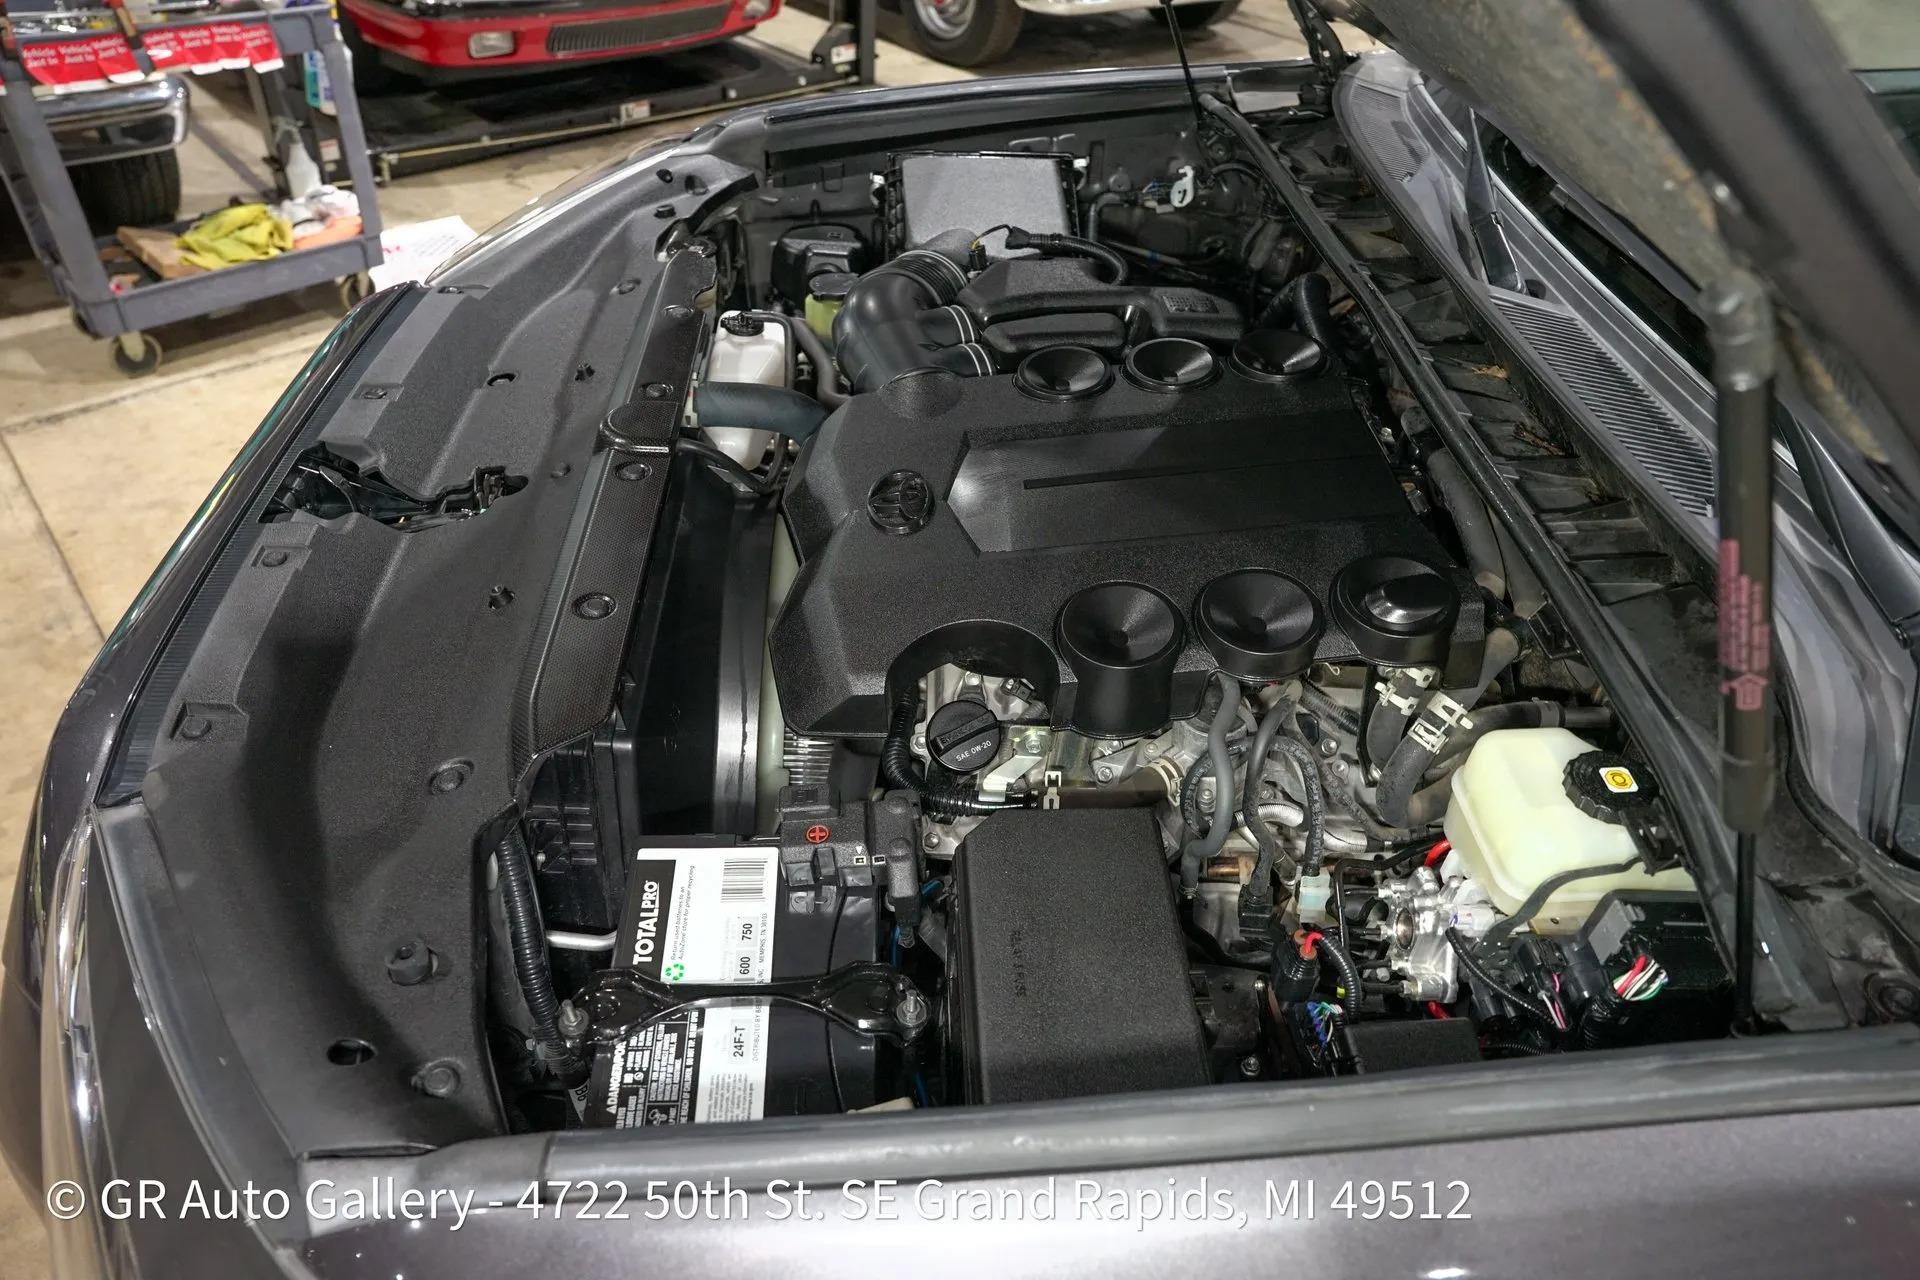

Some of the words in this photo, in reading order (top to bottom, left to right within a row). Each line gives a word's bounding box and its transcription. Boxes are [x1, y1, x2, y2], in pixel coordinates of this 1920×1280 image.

[956, 750, 971, 762] SAE
[686, 865, 696, 889] recycling
[684, 890, 692, 908] proper
[674, 901, 683, 924] batteries
[672, 925, 680, 939] used
[681, 917, 689, 931] store
[741, 923, 752, 940] 750
[670, 940, 678, 960] Return
[739, 956, 751, 975] 600
[733, 1026, 745, 1057] 24F-T
